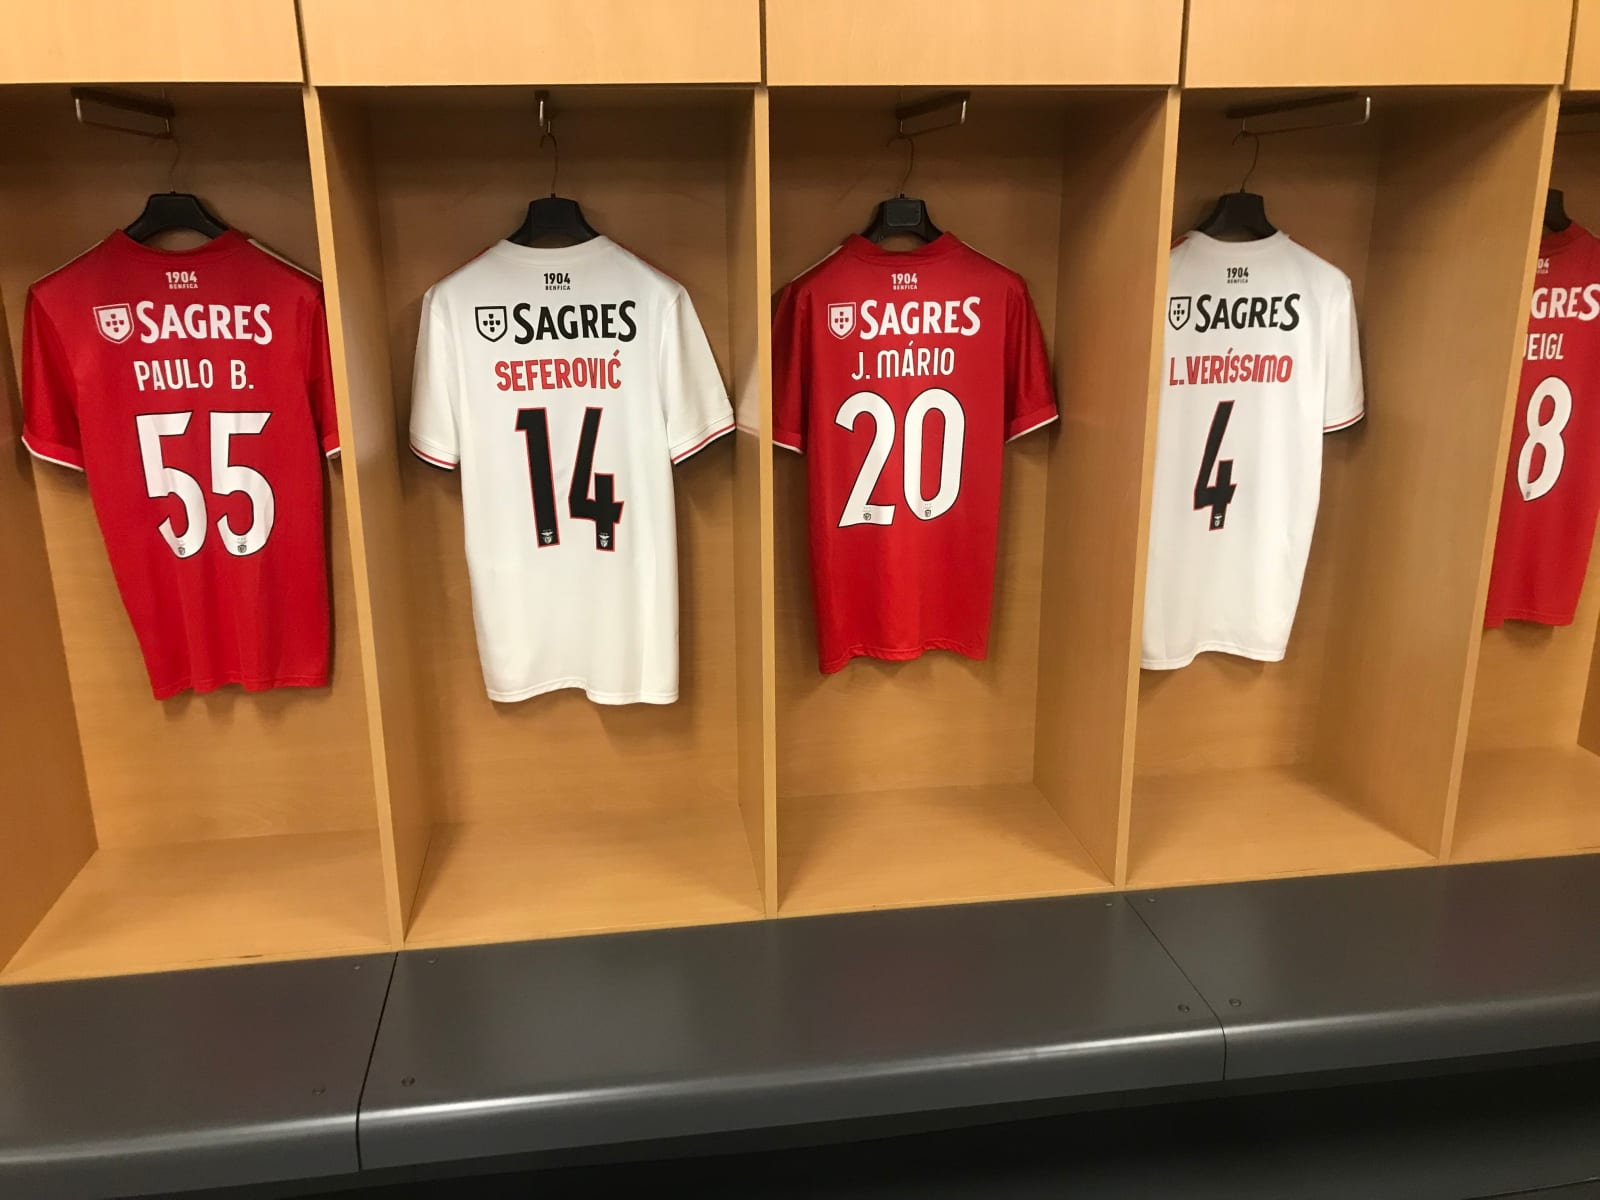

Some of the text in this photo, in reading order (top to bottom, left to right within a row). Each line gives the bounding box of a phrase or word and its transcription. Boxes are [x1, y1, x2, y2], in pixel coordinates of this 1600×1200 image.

[165, 271, 197, 283] 1904
[544, 273, 571, 284] 1904
[891, 273, 918, 285] 1904
[1227, 267, 1249, 278] 1904
[1537, 258, 1549, 268] 04
[136, 300, 273, 345] SAGRES
[512, 300, 637, 345] SAGRES
[859, 296, 981, 341] SAGRES
[1195, 292, 1301, 333] SAGRES
[1531, 283, 1600, 321] GRES
[851, 340, 955, 381] J. MÁRIO
[1523, 333, 1564, 360] EIGL
[133, 358, 254, 392] PAULO B.
[494, 349, 622, 392] SEFEROVIĆ
[834, 387, 966, 529] 20
[1516, 376, 1573, 501] 8
[135, 410, 276, 559] 55
[514, 406, 625, 552] 14
[1193, 399, 1238, 532] 4
